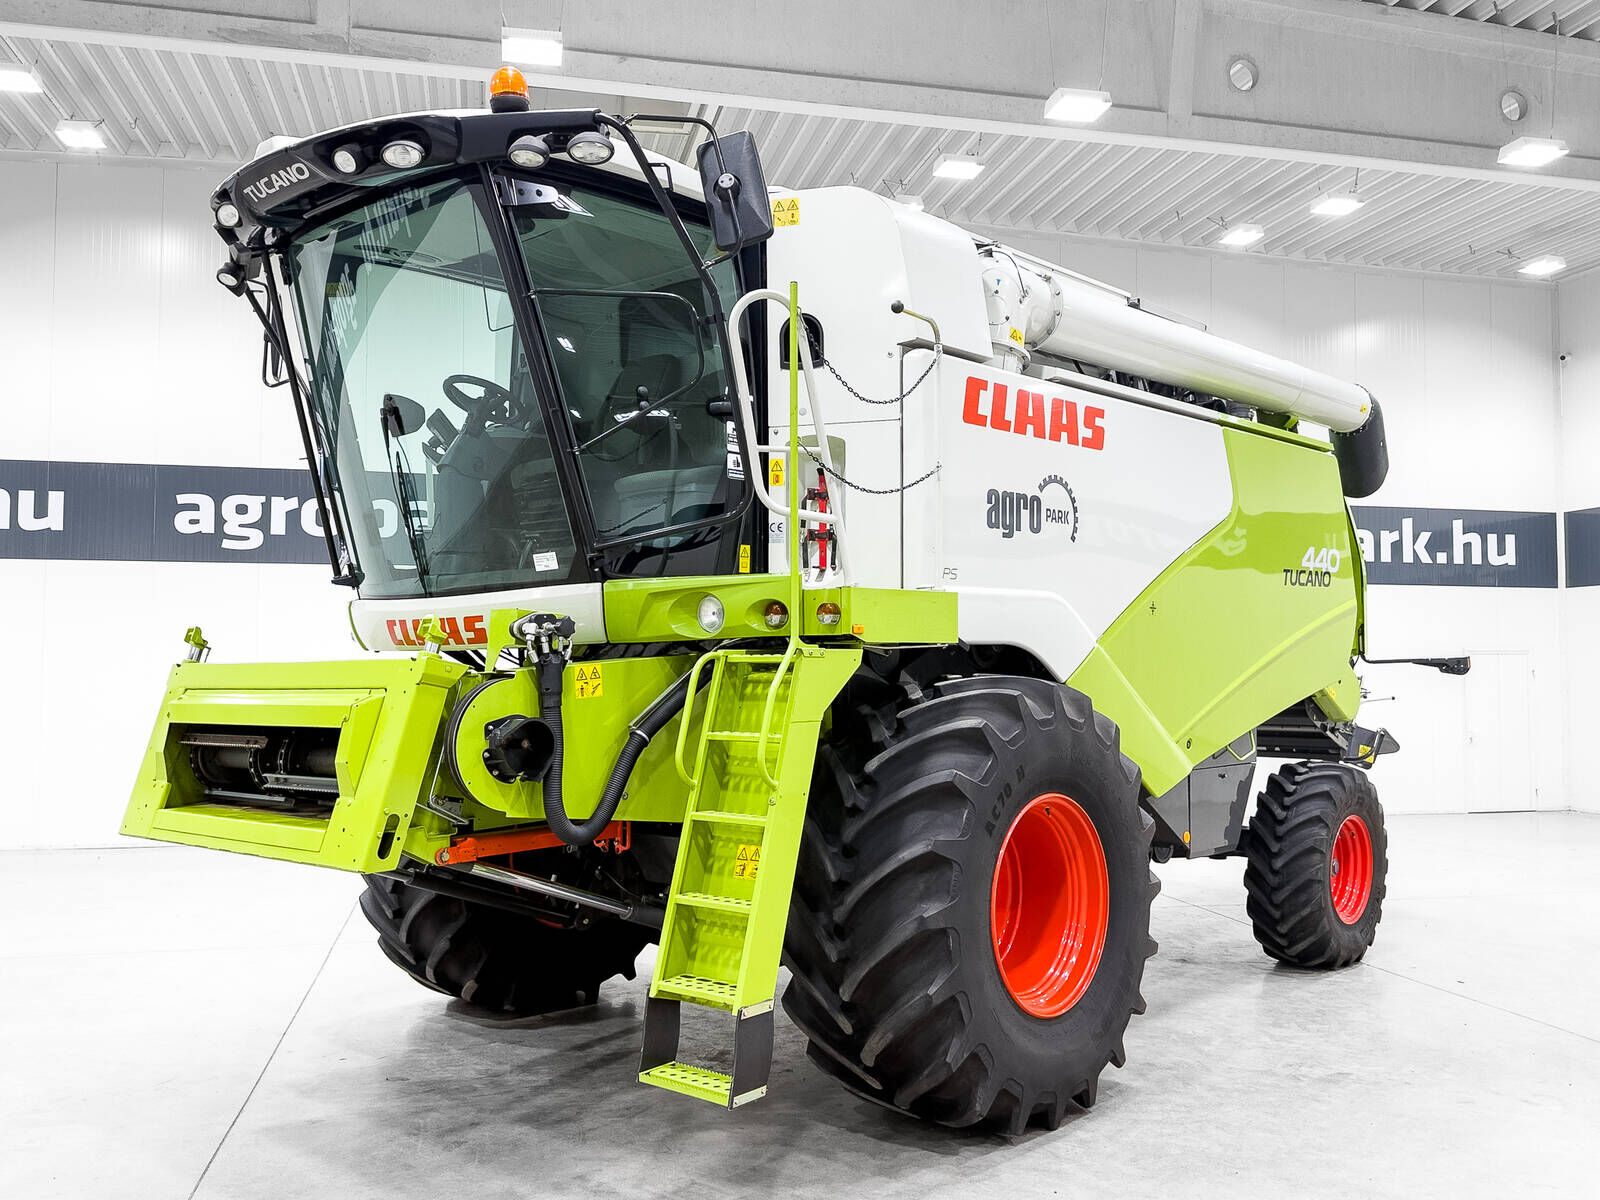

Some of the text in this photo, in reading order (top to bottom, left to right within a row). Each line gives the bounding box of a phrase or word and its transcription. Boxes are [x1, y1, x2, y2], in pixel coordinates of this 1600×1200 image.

[243, 163, 310, 202] TUCANO
[963, 376, 1105, 450] CLAAS
[987, 489, 1070, 538] agro PARK
[1283, 568, 1331, 587] TUCANO
[1302, 546, 1340, 573] 440
